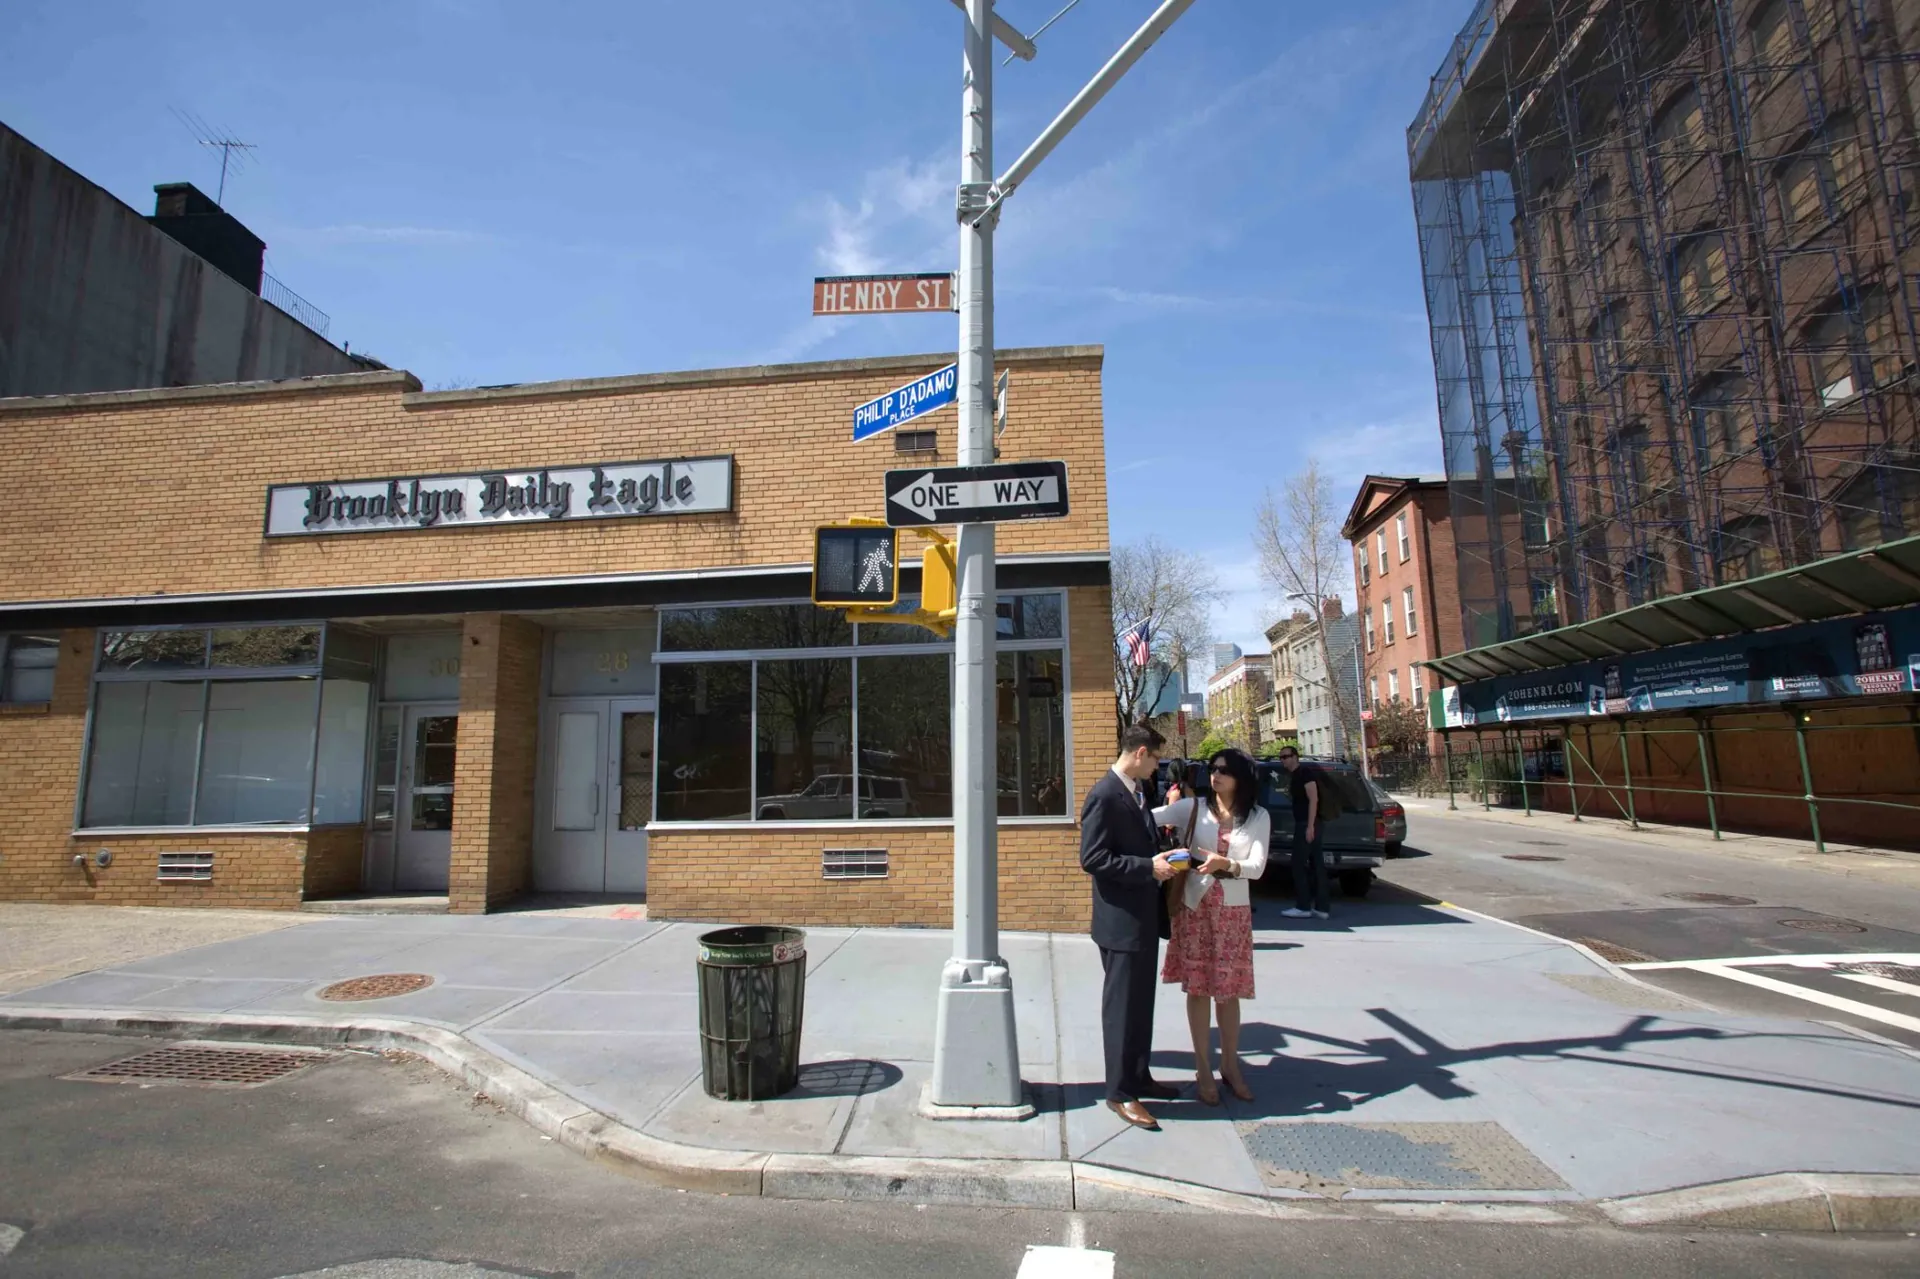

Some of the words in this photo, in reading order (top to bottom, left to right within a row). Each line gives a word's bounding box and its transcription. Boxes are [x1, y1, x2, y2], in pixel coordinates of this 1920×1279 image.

[822, 281, 902, 312] HENRY
[916, 279, 944, 309] ST
[856, 396, 893, 429] PHILIP
[899, 369, 955, 410] D'ADAMO
[889, 405, 915, 425] PLACE
[302, 479, 464, 527] Brooklyn
[479, 470, 572, 518] Daily
[587, 461, 693, 513] Eagle
[911, 484, 960, 508] ONE
[993, 479, 1045, 503] WAY
[598, 650, 630, 673] 28
[1785, 681, 1820, 689] PROPERTY
[1855, 673, 1901, 683] 20HENRY
[1507, 681, 1583, 701] 20HENRY.COM
